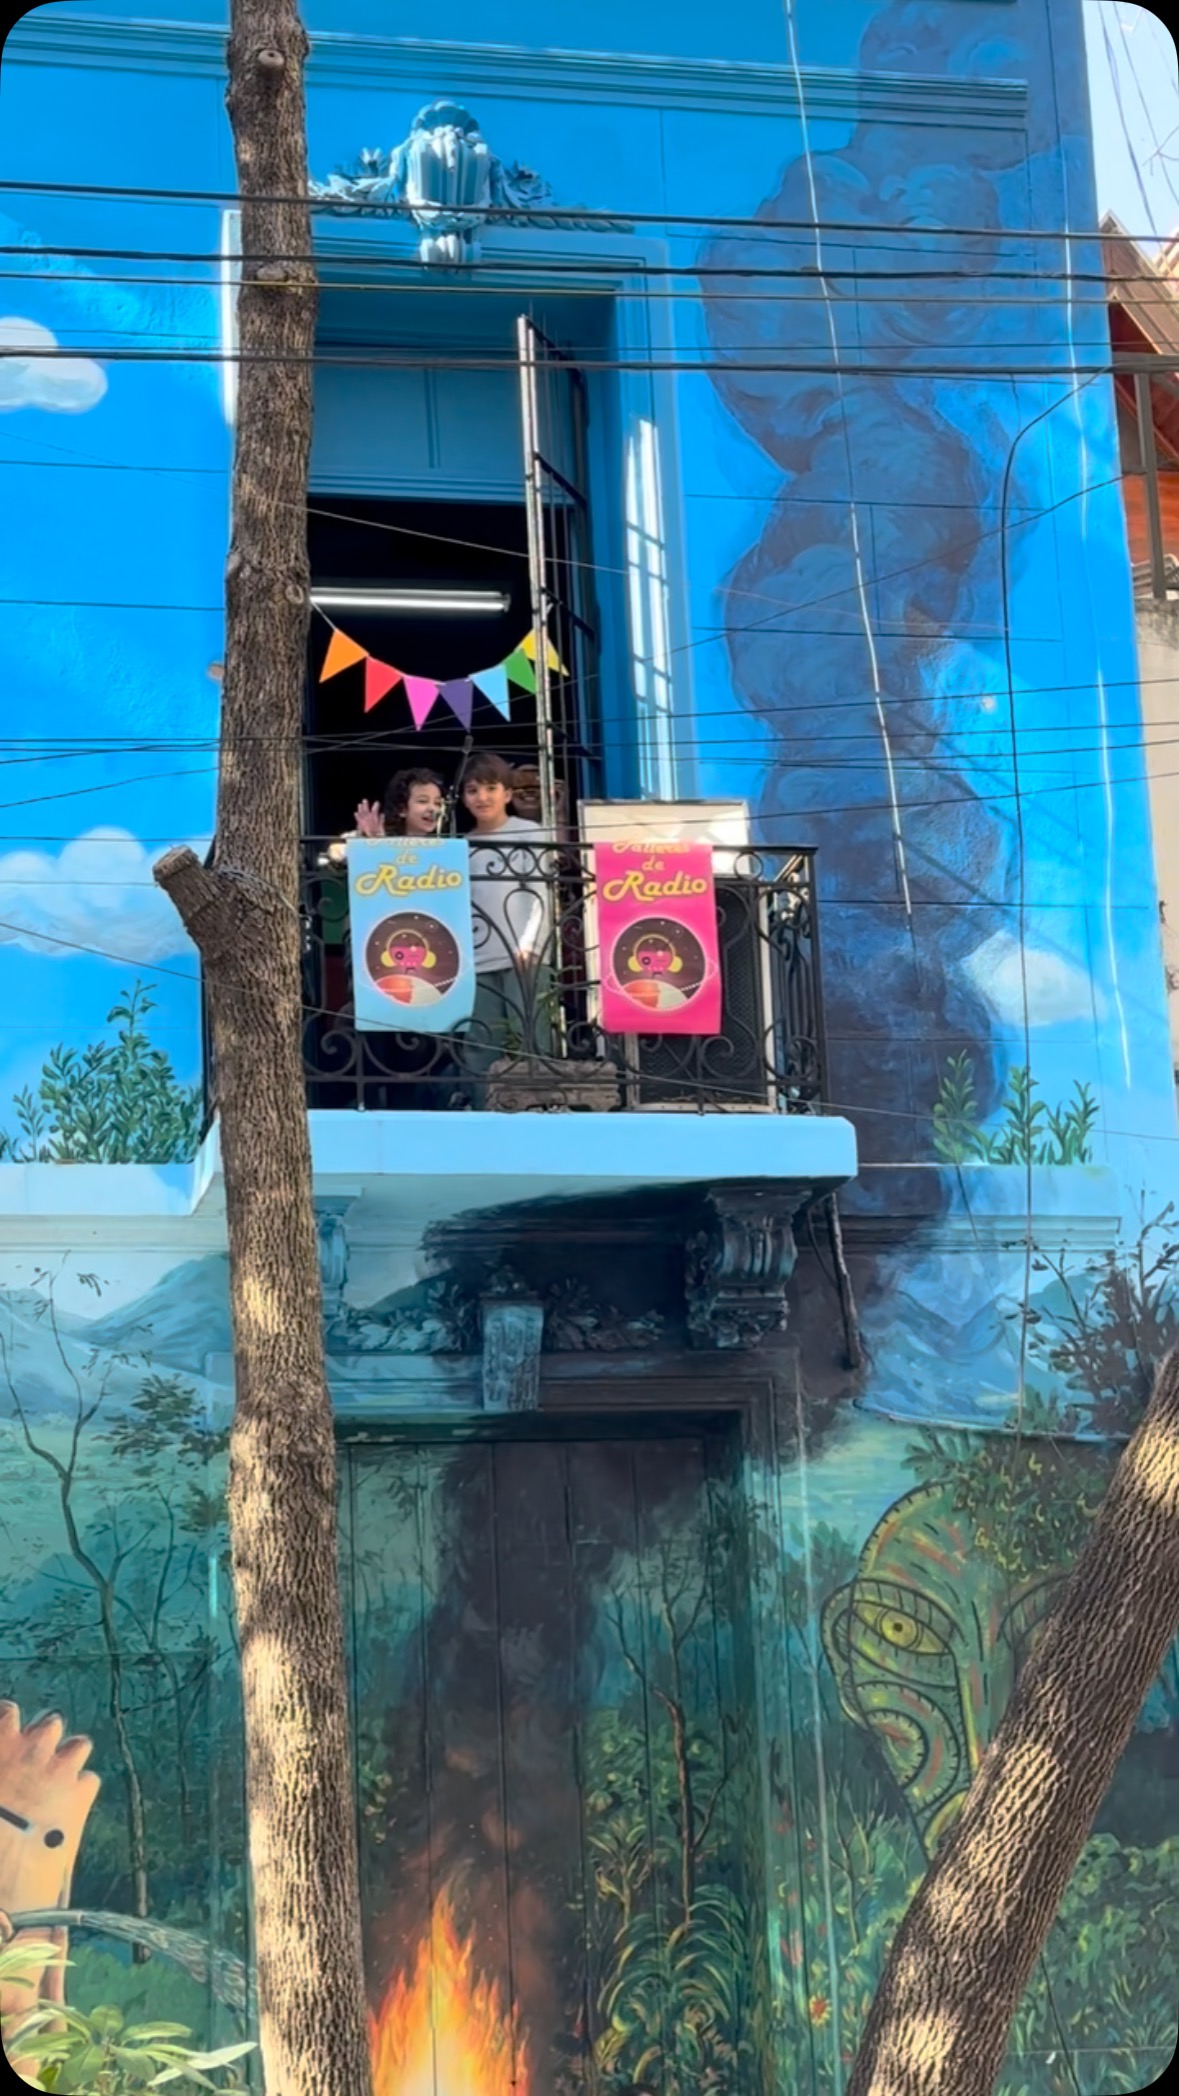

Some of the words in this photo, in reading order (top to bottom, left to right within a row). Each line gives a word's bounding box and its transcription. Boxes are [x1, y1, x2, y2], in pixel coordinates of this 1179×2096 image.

[395, 849, 418, 865] de
[641, 855, 665, 872] de
[355, 863, 463, 897] Radio
[602, 870, 708, 902] Radio
